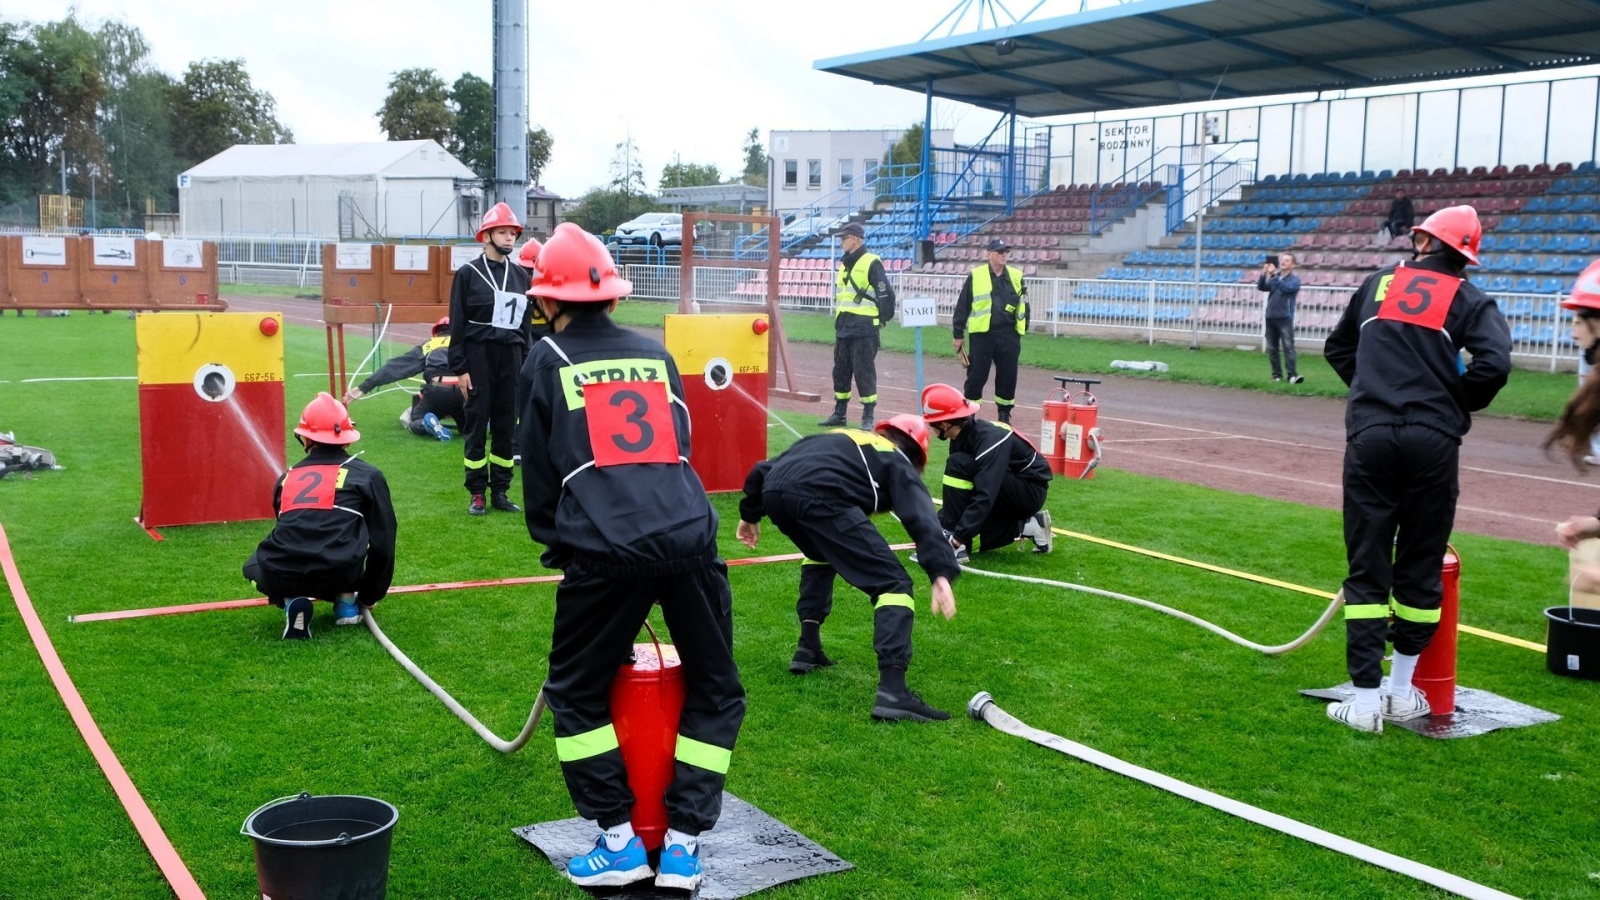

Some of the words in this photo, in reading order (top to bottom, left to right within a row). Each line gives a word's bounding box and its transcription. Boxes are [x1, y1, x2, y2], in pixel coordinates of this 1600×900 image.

[1105, 125, 1149, 137] SEKTOR
[1100, 138, 1151, 151] RODZINNY
[180, 175, 188, 186] F
[110, 274, 119, 285] 4
[179, 275, 186, 286] 5
[407, 276, 414, 286] 7
[1398, 275, 1439, 316] 5
[504, 297, 518, 325] 1
[904, 306, 934, 316] START
[244, 372, 275, 382] 667-56
[609, 389, 655, 454] 3
[292, 471, 323, 505] 2
